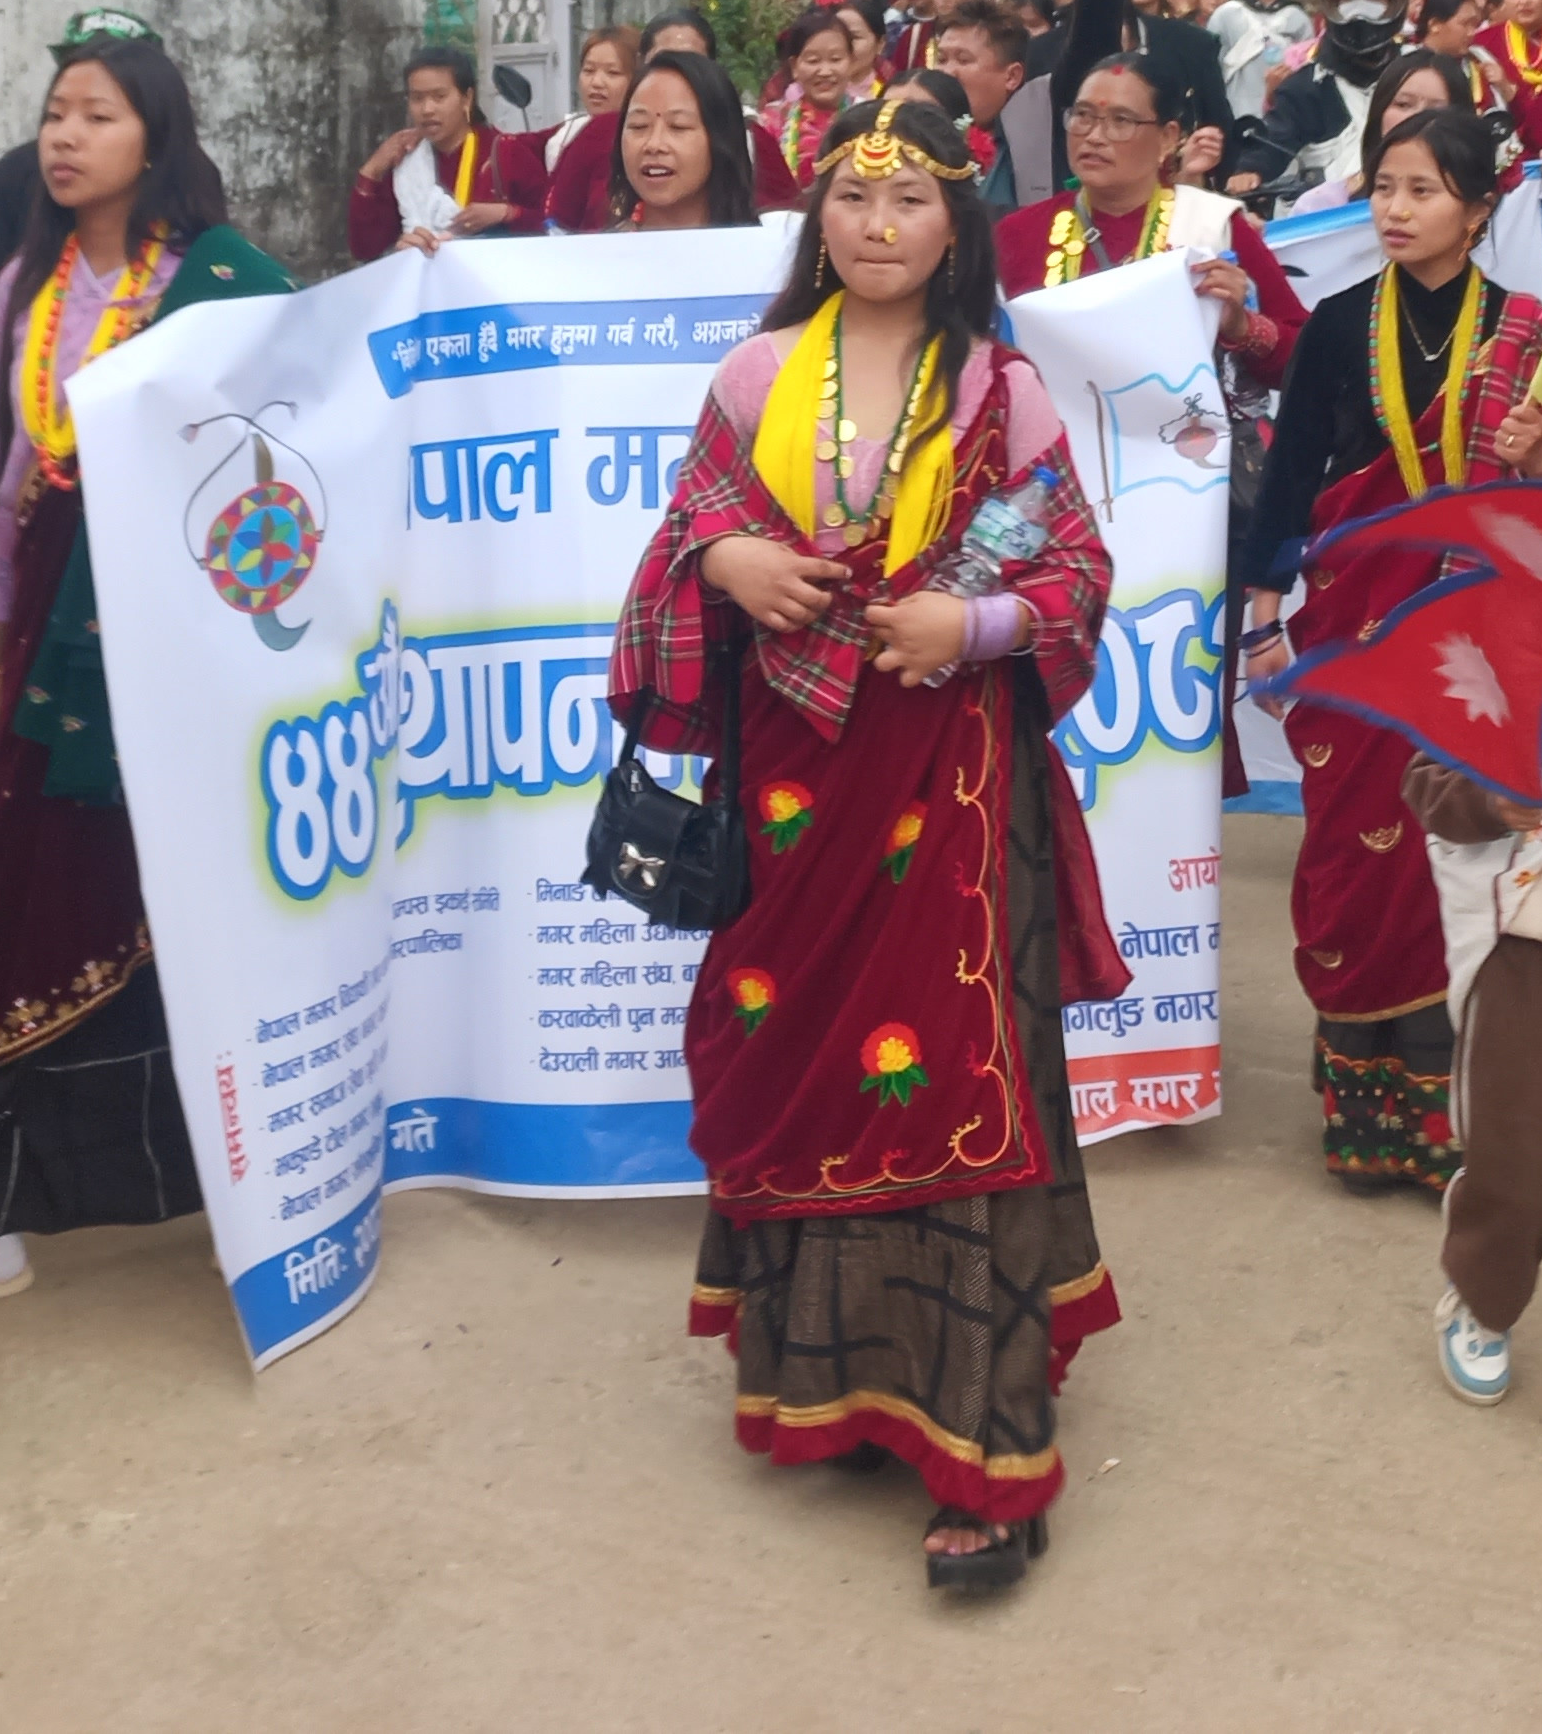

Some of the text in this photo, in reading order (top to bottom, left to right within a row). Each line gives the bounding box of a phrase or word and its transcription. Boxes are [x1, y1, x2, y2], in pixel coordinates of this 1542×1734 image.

[425, 332, 471, 366] एकता
[506, 323, 546, 351] मगर
[549, 322, 597, 355] हुनुमा
[606, 317, 636, 348] गर्व
[408, 428, 560, 528] पाल
[1067, 594, 1224, 796] ०८
[1168, 846, 1221, 893] आयो
[389, 928, 463, 960] रपालिका
[536, 925, 576, 944] मगर
[579, 917, 637, 945] महिला
[1117, 921, 1200, 959] नेपाल
[536, 967, 577, 987] मगर
[580, 960, 638, 988] महिला
[627, 1007, 656, 1033] पुन
[1061, 990, 1219, 1038] ागलुङ नगर
[604, 1051, 650, 1071] मगर
[1127, 1072, 1203, 1115] मगर
[389, 1107, 439, 1153] गते
